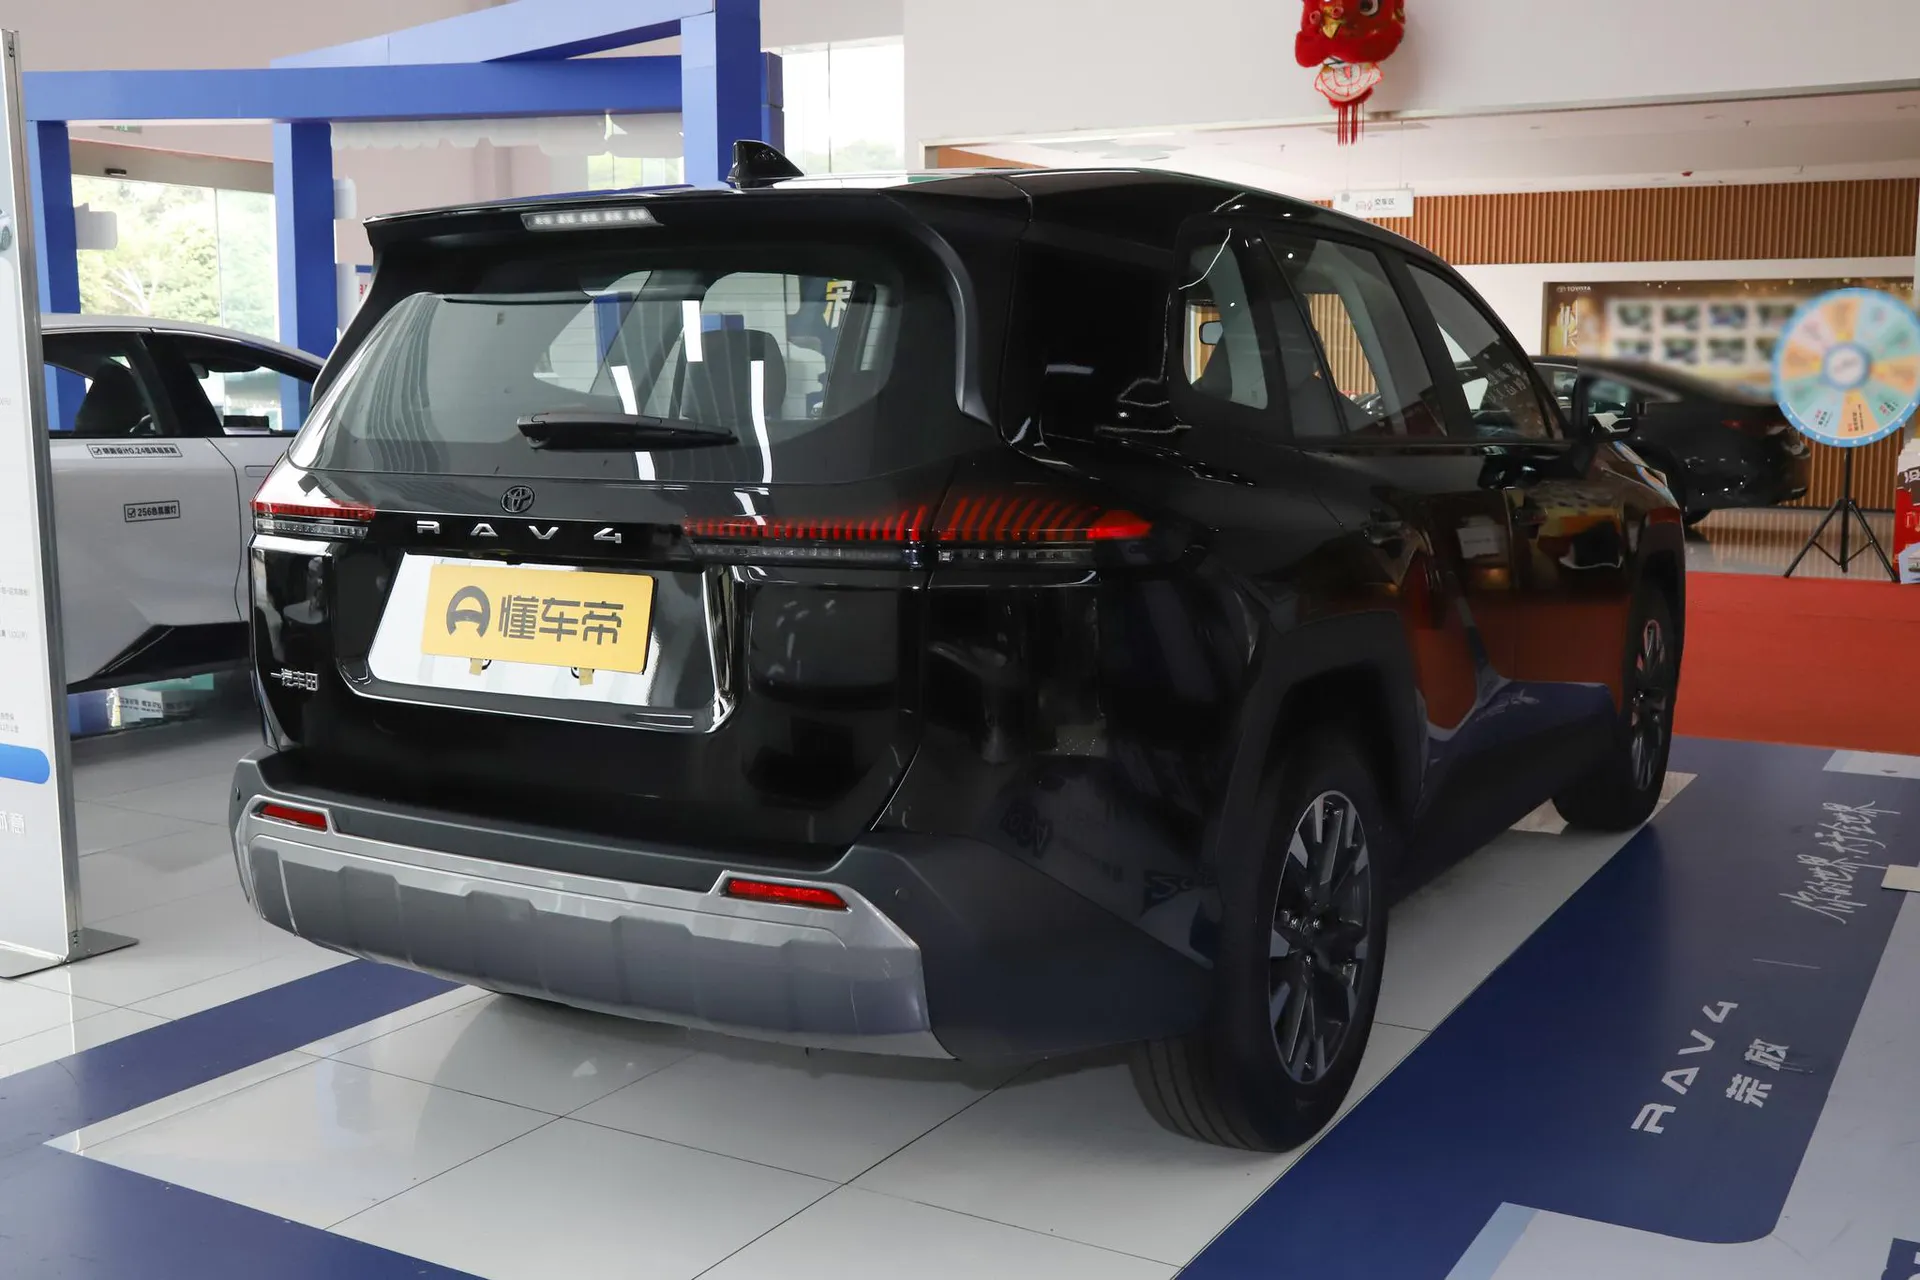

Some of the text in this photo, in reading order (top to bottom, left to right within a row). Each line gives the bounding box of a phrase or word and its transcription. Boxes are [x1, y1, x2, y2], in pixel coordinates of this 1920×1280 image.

[416, 520, 623, 544] RAV4
[498, 594, 624, 645] 懂车帝
[1630, 1001, 1740, 1134] RAV4
[1725, 1037, 1790, 1109] 荣放
